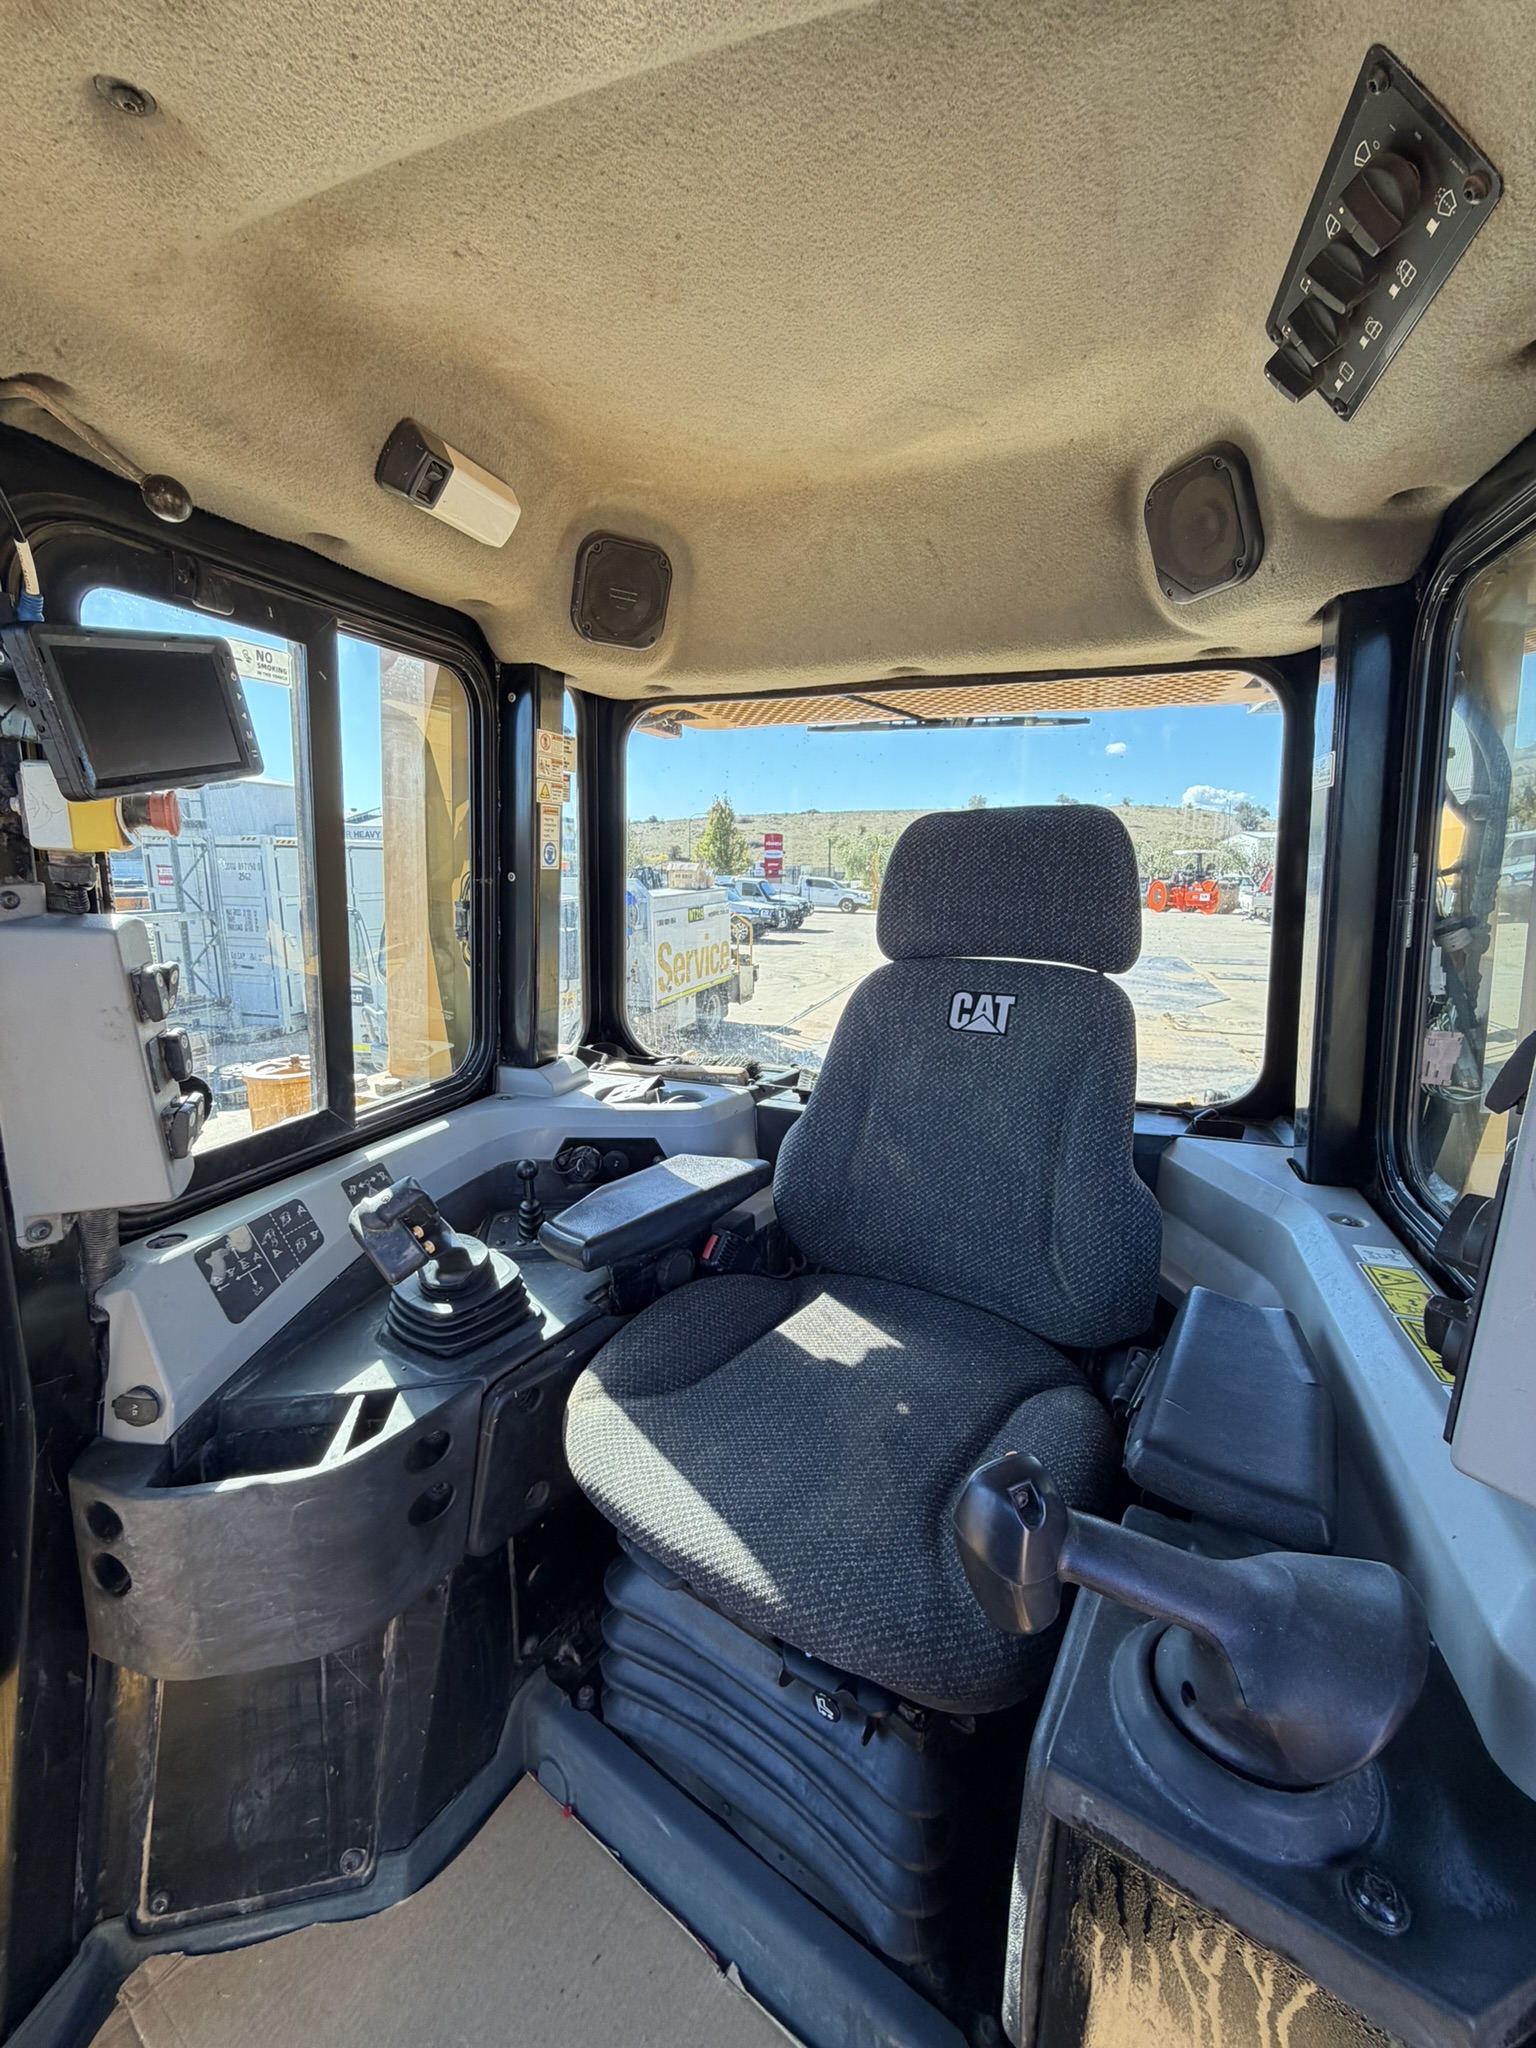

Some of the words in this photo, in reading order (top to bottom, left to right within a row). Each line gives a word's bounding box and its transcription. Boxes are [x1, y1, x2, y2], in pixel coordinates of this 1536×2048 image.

[256, 649, 273, 664] NO
[257, 663, 288, 675] SMOKING
[353, 831, 381, 839] HEAVY
[657, 932, 730, 992] Service
[948, 990, 1016, 1034] CAT
